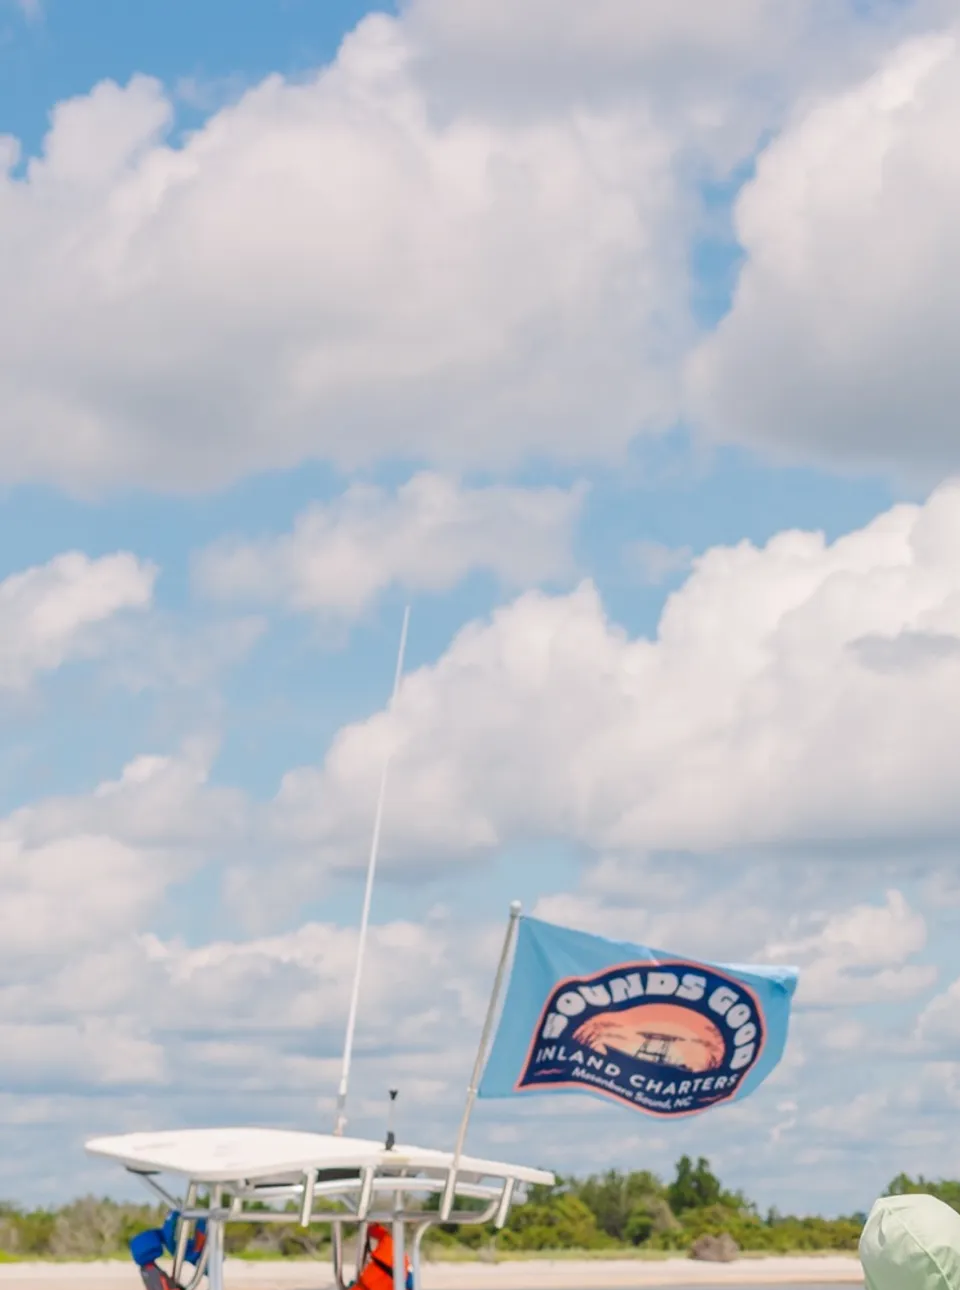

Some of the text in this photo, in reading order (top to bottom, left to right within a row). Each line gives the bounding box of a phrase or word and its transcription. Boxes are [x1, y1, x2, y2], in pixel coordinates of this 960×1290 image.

[542, 971, 757, 1070] SOUNDS GOOD
[535, 1045, 740, 1097] INLAND CHARTERS
